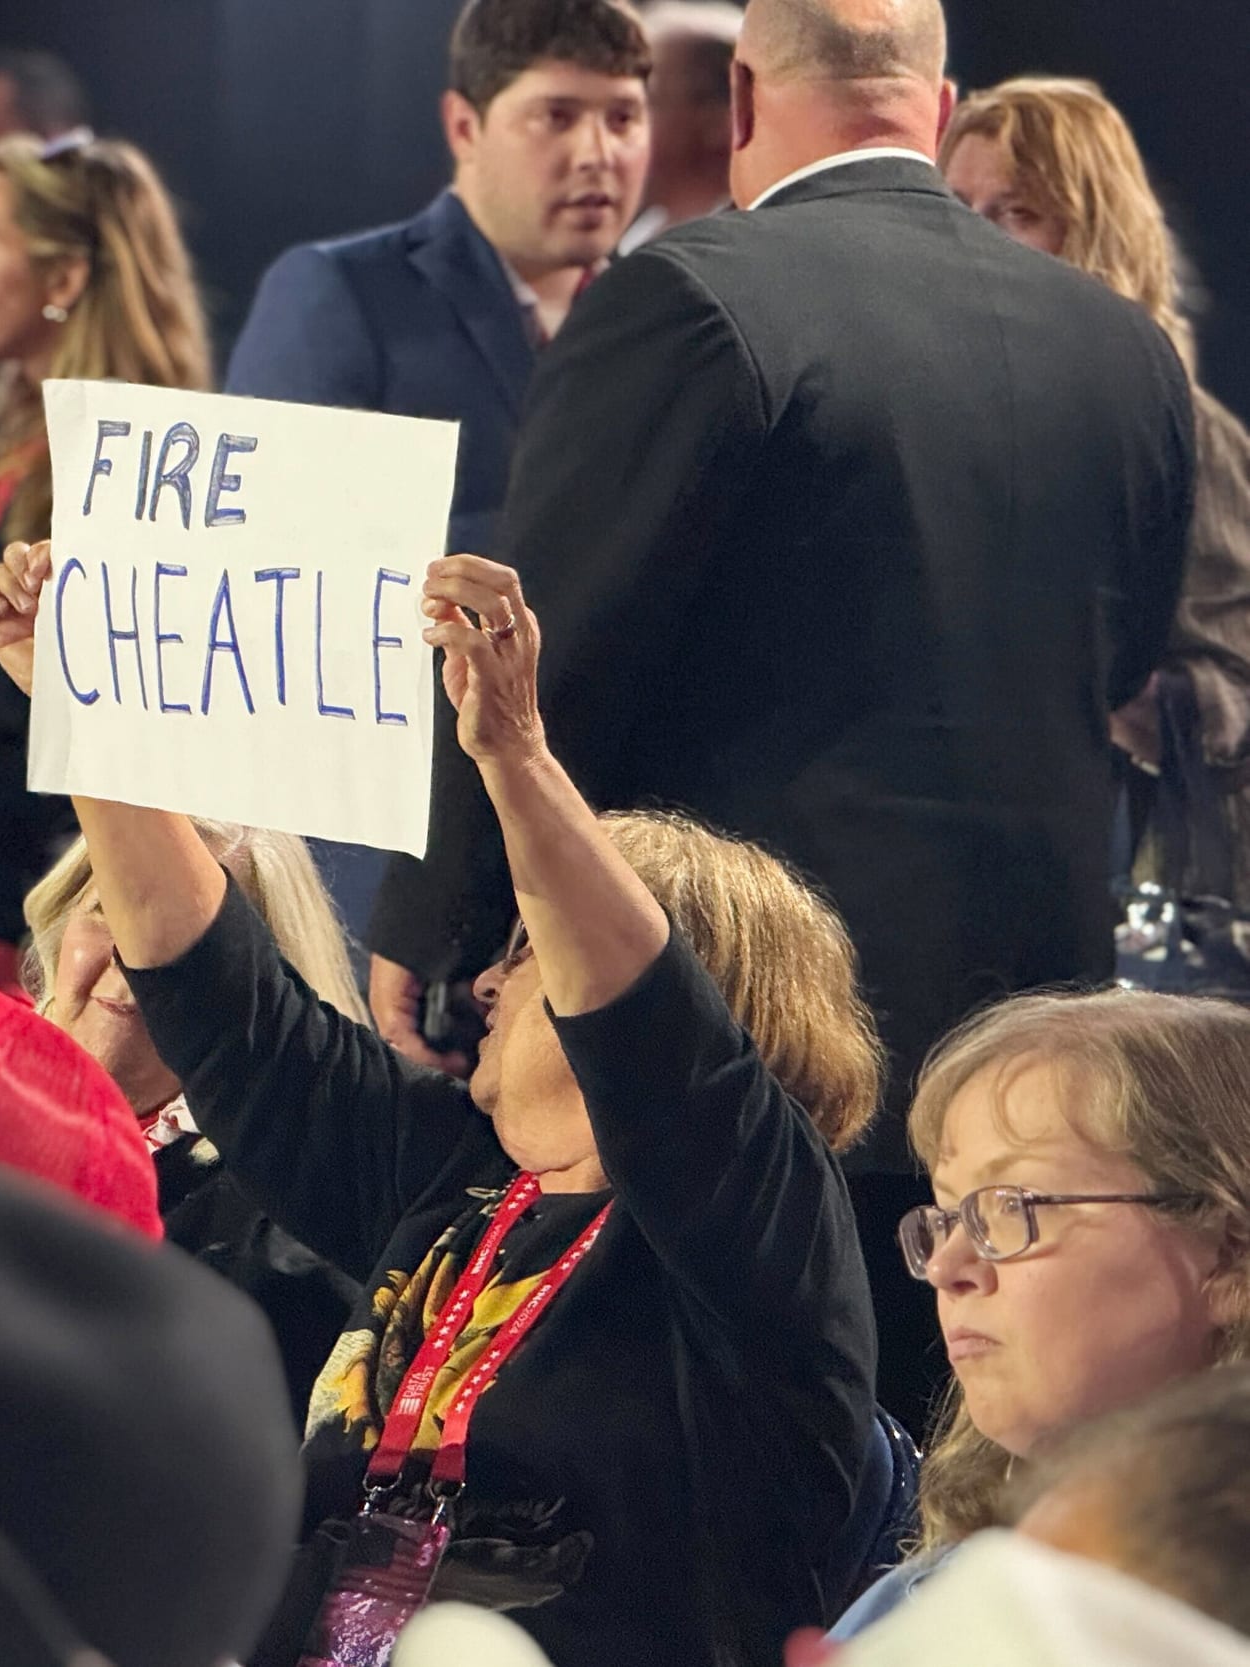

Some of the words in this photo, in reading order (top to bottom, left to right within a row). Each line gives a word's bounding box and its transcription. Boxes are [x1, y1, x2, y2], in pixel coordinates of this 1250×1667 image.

[82, 420, 258, 530] FIRE
[53, 556, 411, 727] CHEATLE
[402, 1372, 422, 1399] DATA
[413, 1365, 435, 1397] TRUST
